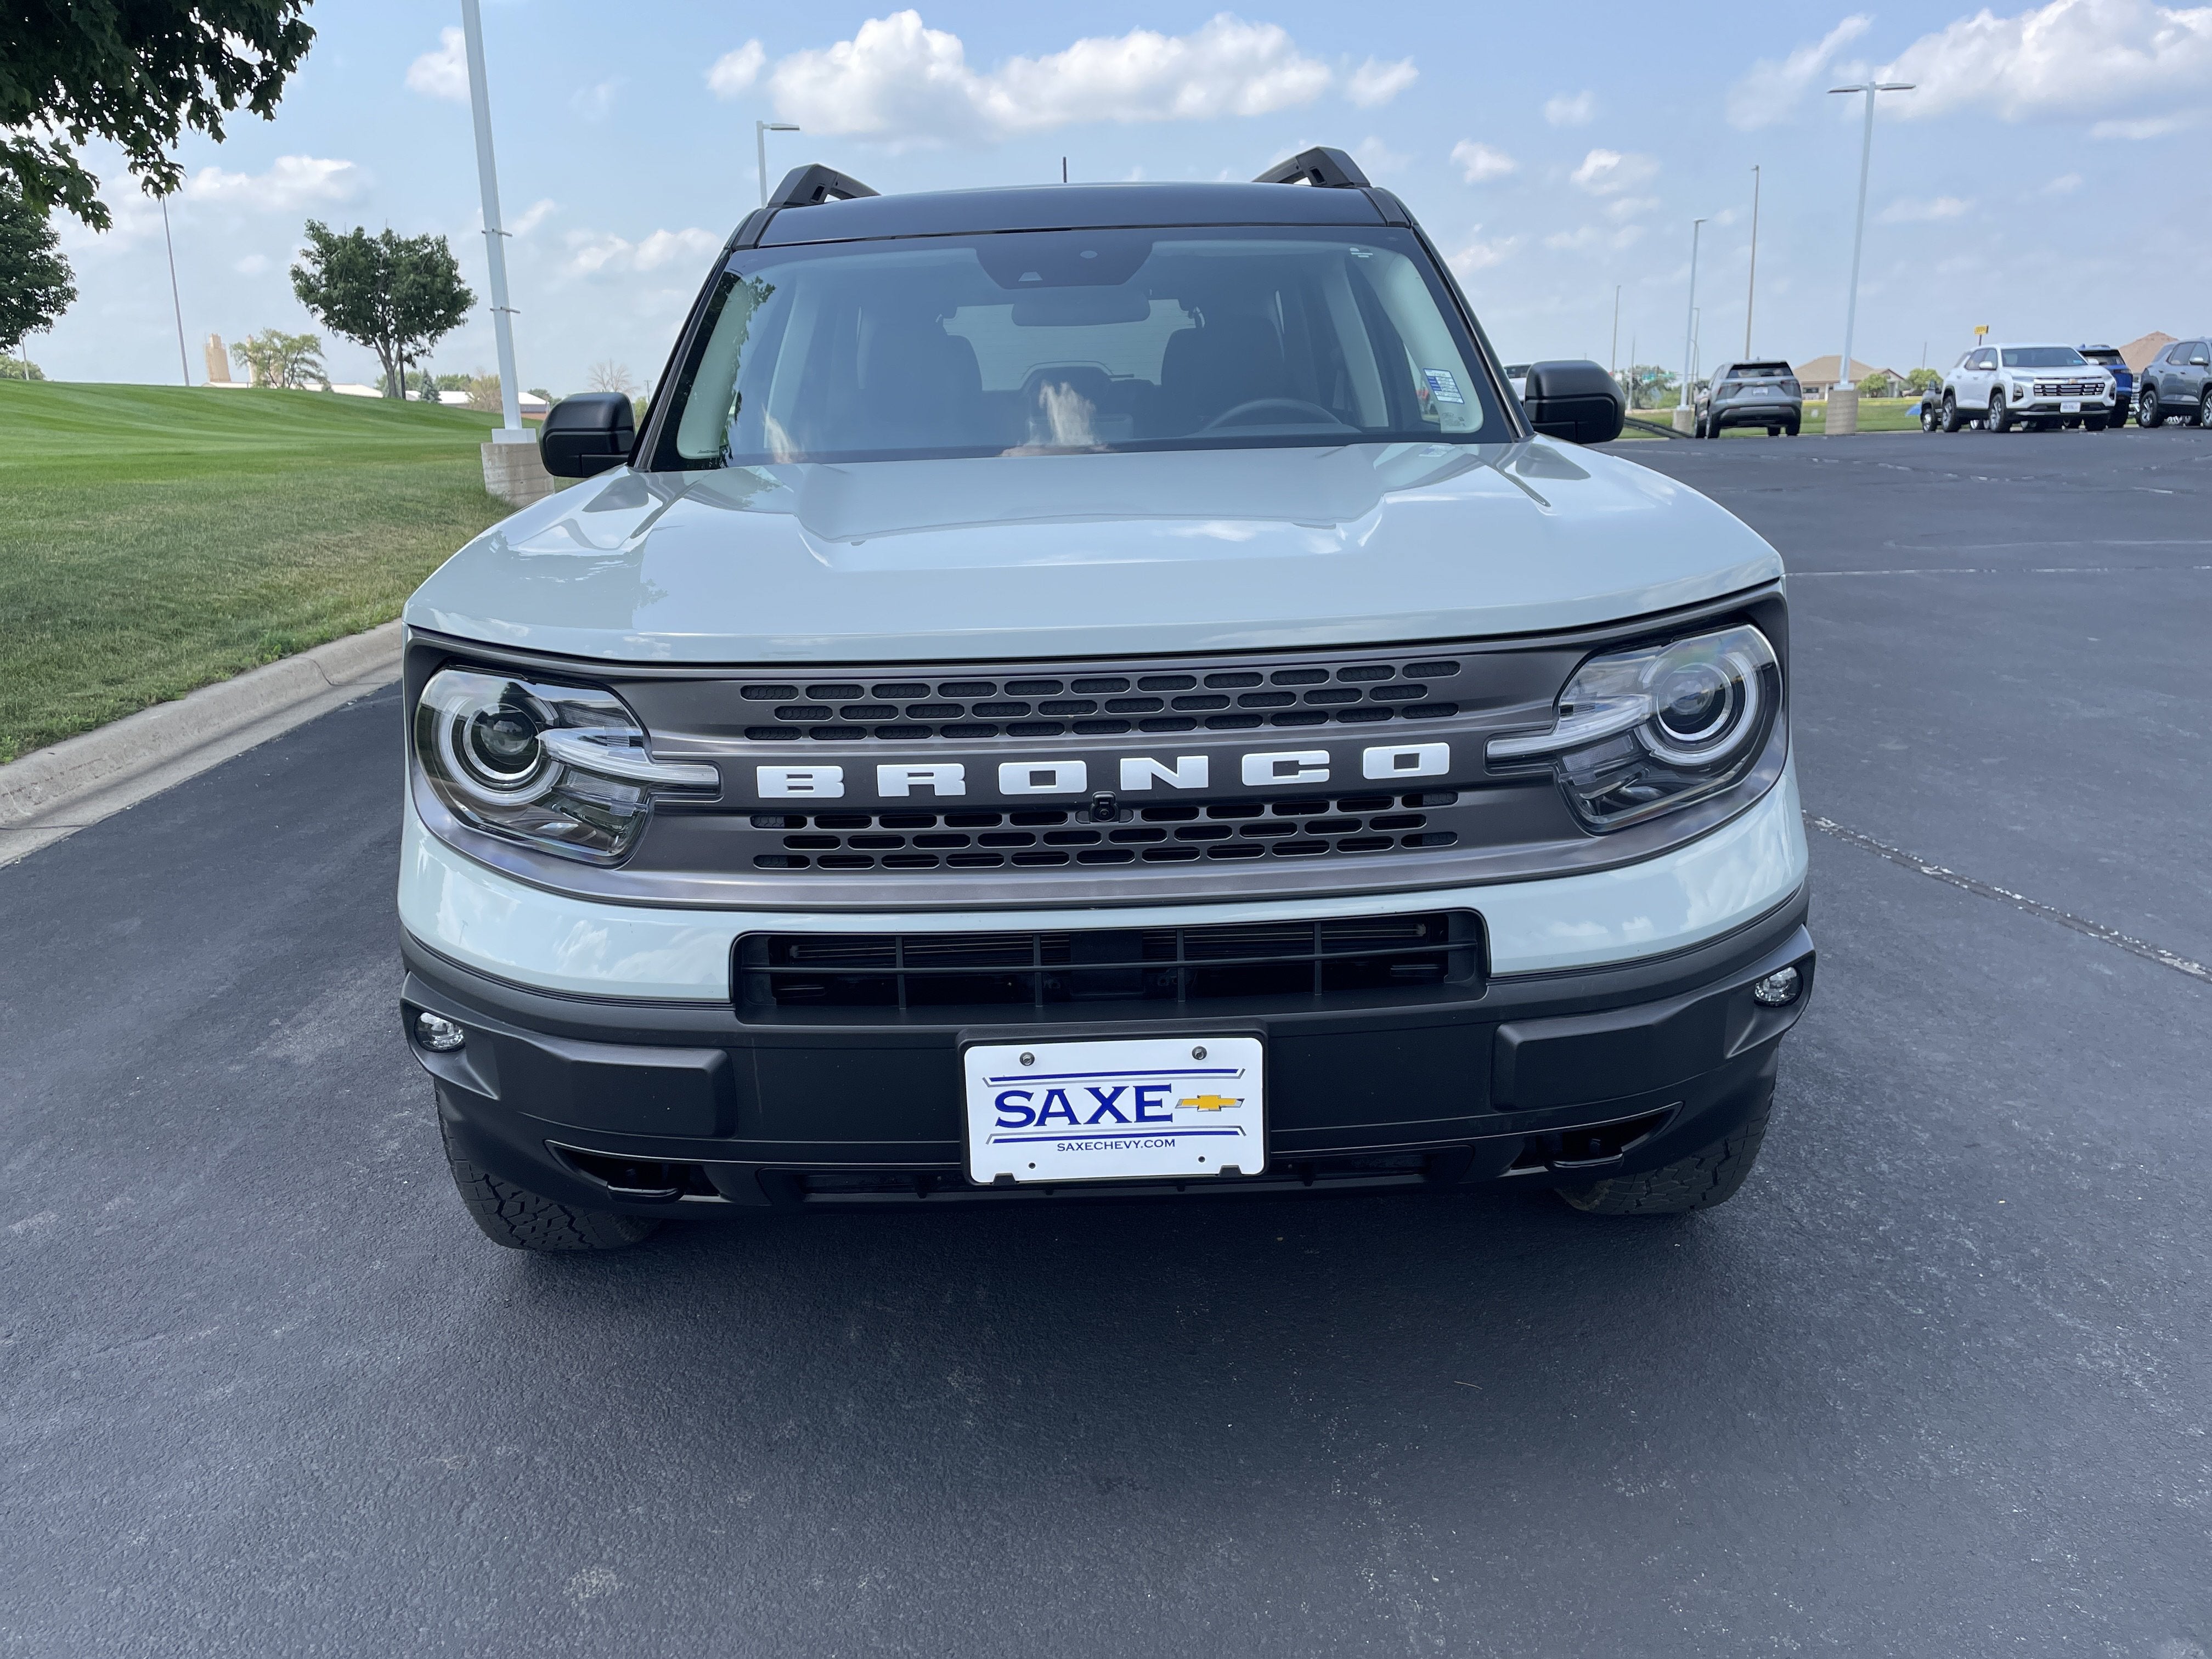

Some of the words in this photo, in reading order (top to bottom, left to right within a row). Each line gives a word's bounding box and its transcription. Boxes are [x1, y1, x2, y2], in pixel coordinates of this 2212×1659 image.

[756, 742, 1450, 798] BRONCO
[994, 1084, 1173, 1128] SAXE
[1057, 1138, 1176, 1152] SAXECHEVY.COM
